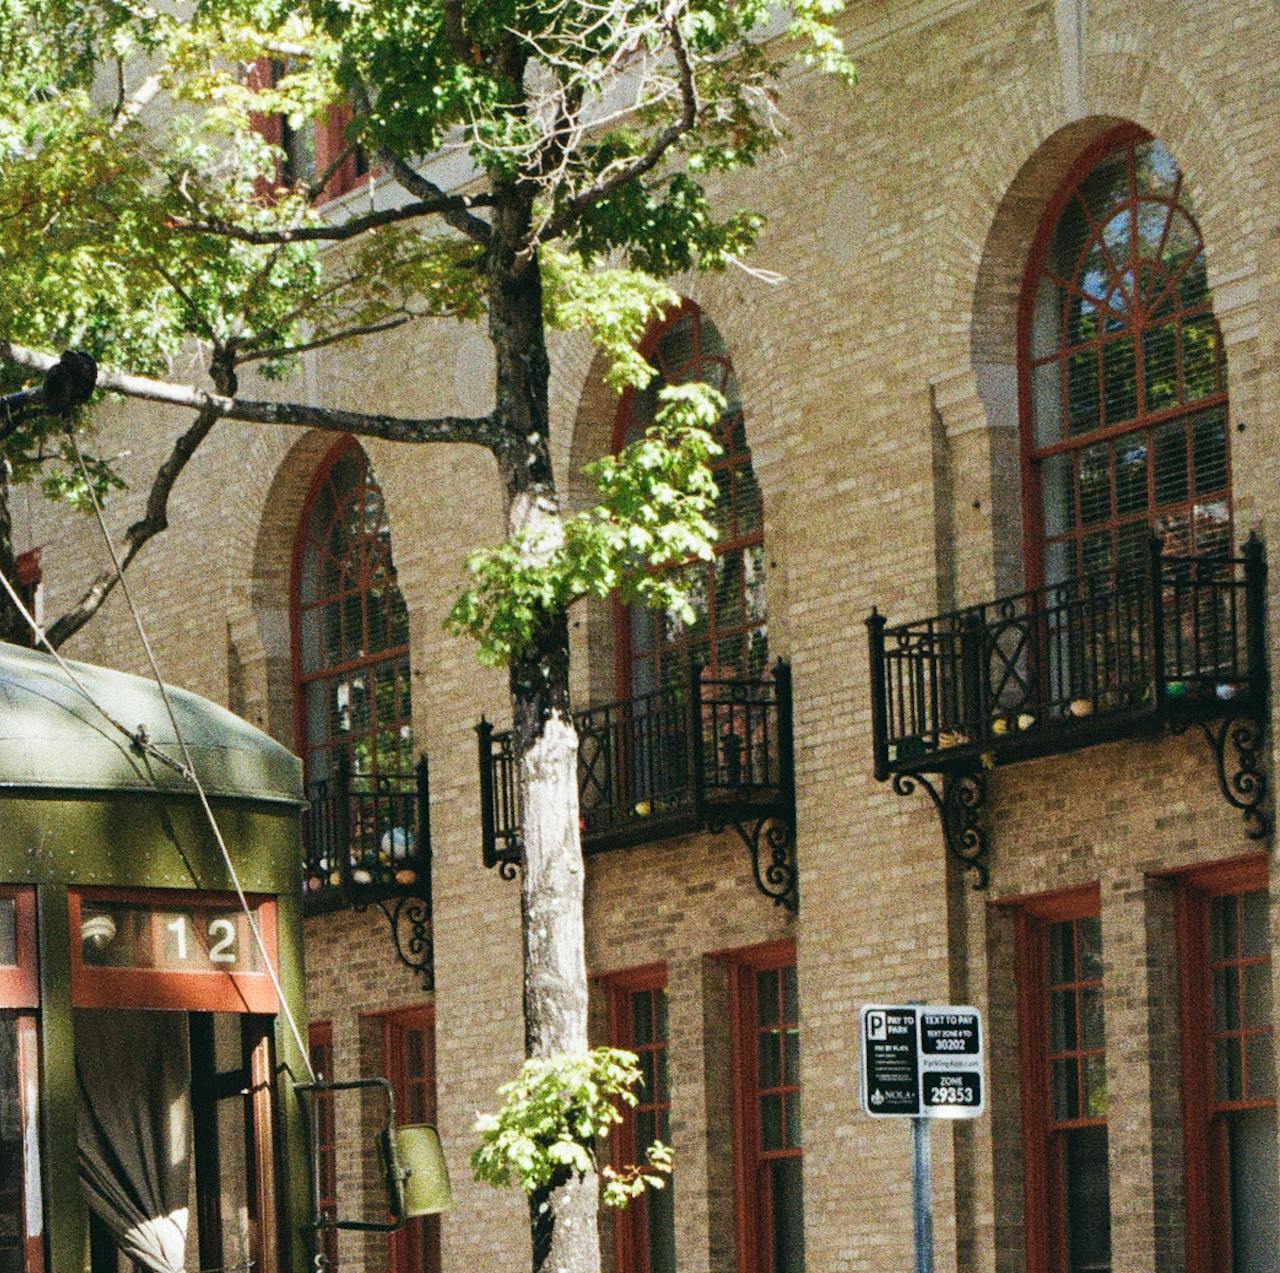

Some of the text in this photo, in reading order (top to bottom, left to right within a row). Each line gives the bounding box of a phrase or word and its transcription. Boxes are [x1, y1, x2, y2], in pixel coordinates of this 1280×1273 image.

[871, 1015, 883, 1036] P
[887, 1015, 915, 1025] PAY TO
[925, 1015, 973, 1026] TEXT TO PAY
[887, 1025, 909, 1035] PARK
[935, 1038, 966, 1051] 30202
[940, 1076, 963, 1087] ZONE
[930, 1086, 974, 1104] 29353
